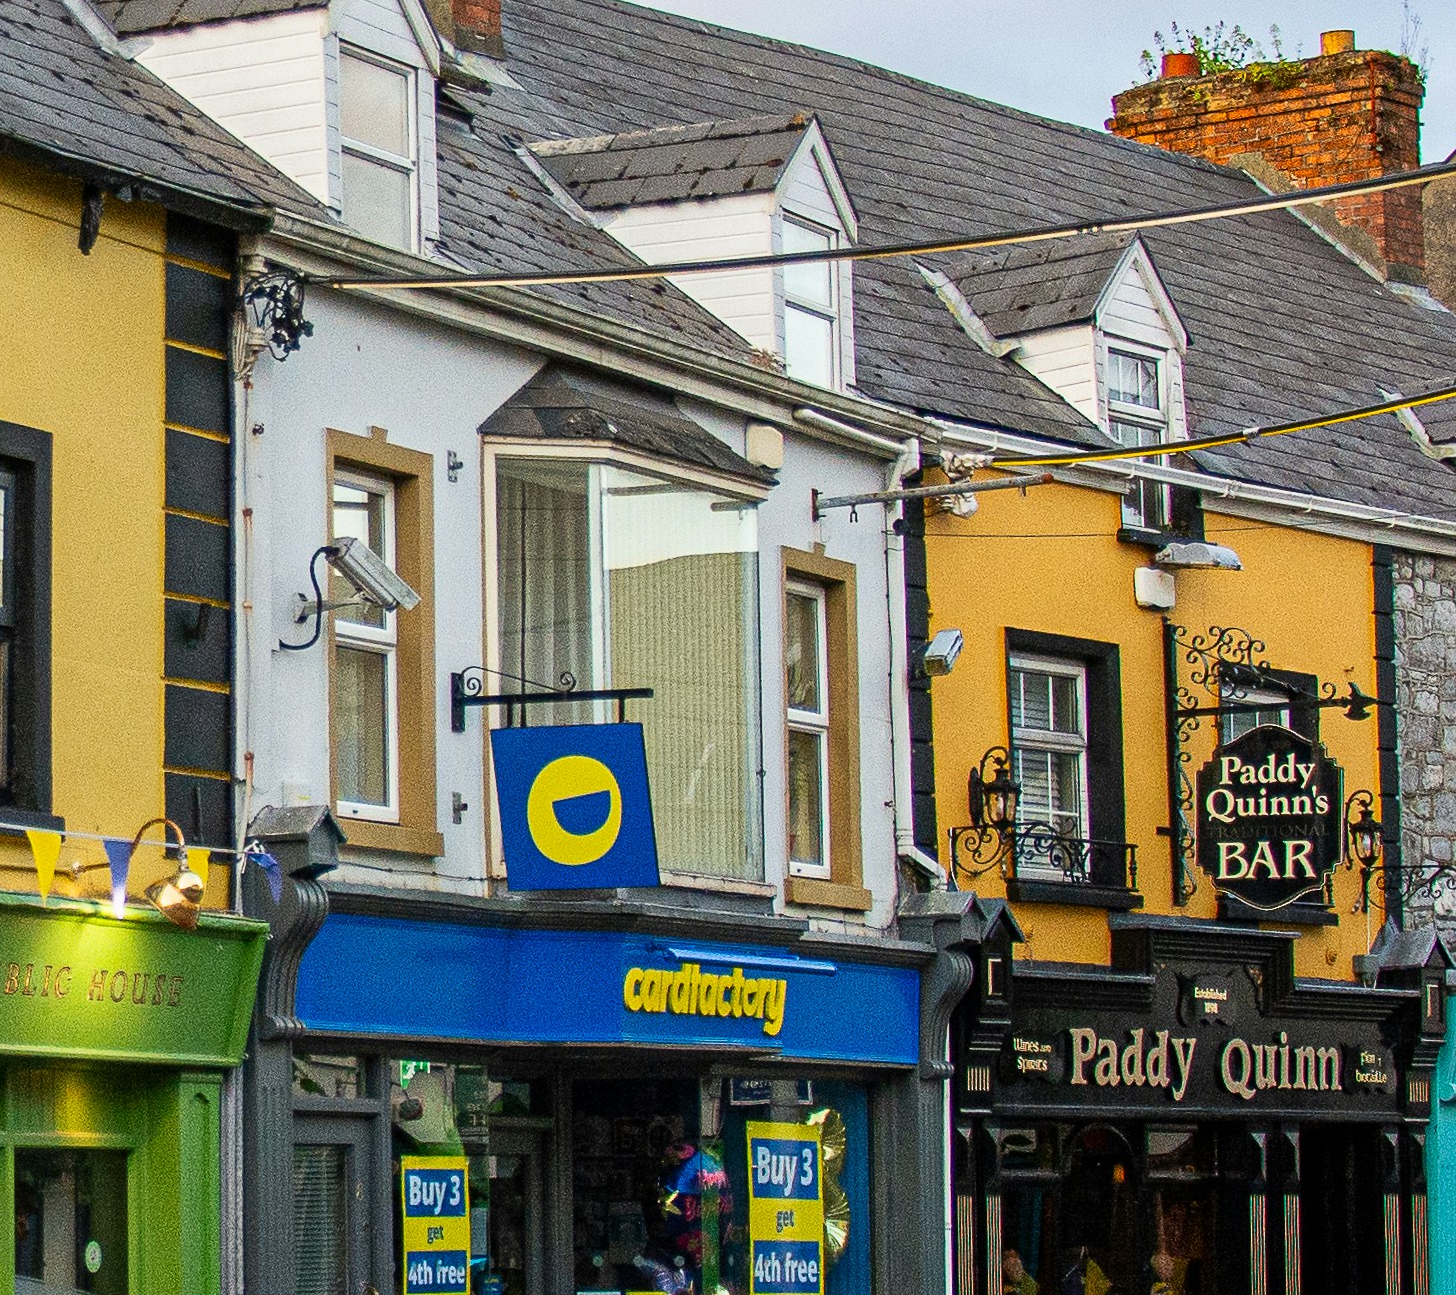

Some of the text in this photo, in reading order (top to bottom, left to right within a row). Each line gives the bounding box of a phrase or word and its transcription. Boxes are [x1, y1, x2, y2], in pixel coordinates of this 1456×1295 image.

[1219, 753, 1316, 789] Paddy
[1206, 785, 1329, 822] Quinn's
[1216, 840, 1317, 880] BAR
[89, 970, 184, 1006] HOUSE
[623, 963, 787, 1036] cardfactory
[1070, 1028, 1343, 1101] Paddy Quinn
[757, 1146, 813, 1196] Buy 3
[409, 1175, 461, 1215] Buy 3
[427, 1226, 444, 1244] get
[776, 1209, 794, 1233] get
[408, 1259, 465, 1285] 4th free
[754, 1252, 818, 1283] 4th free
